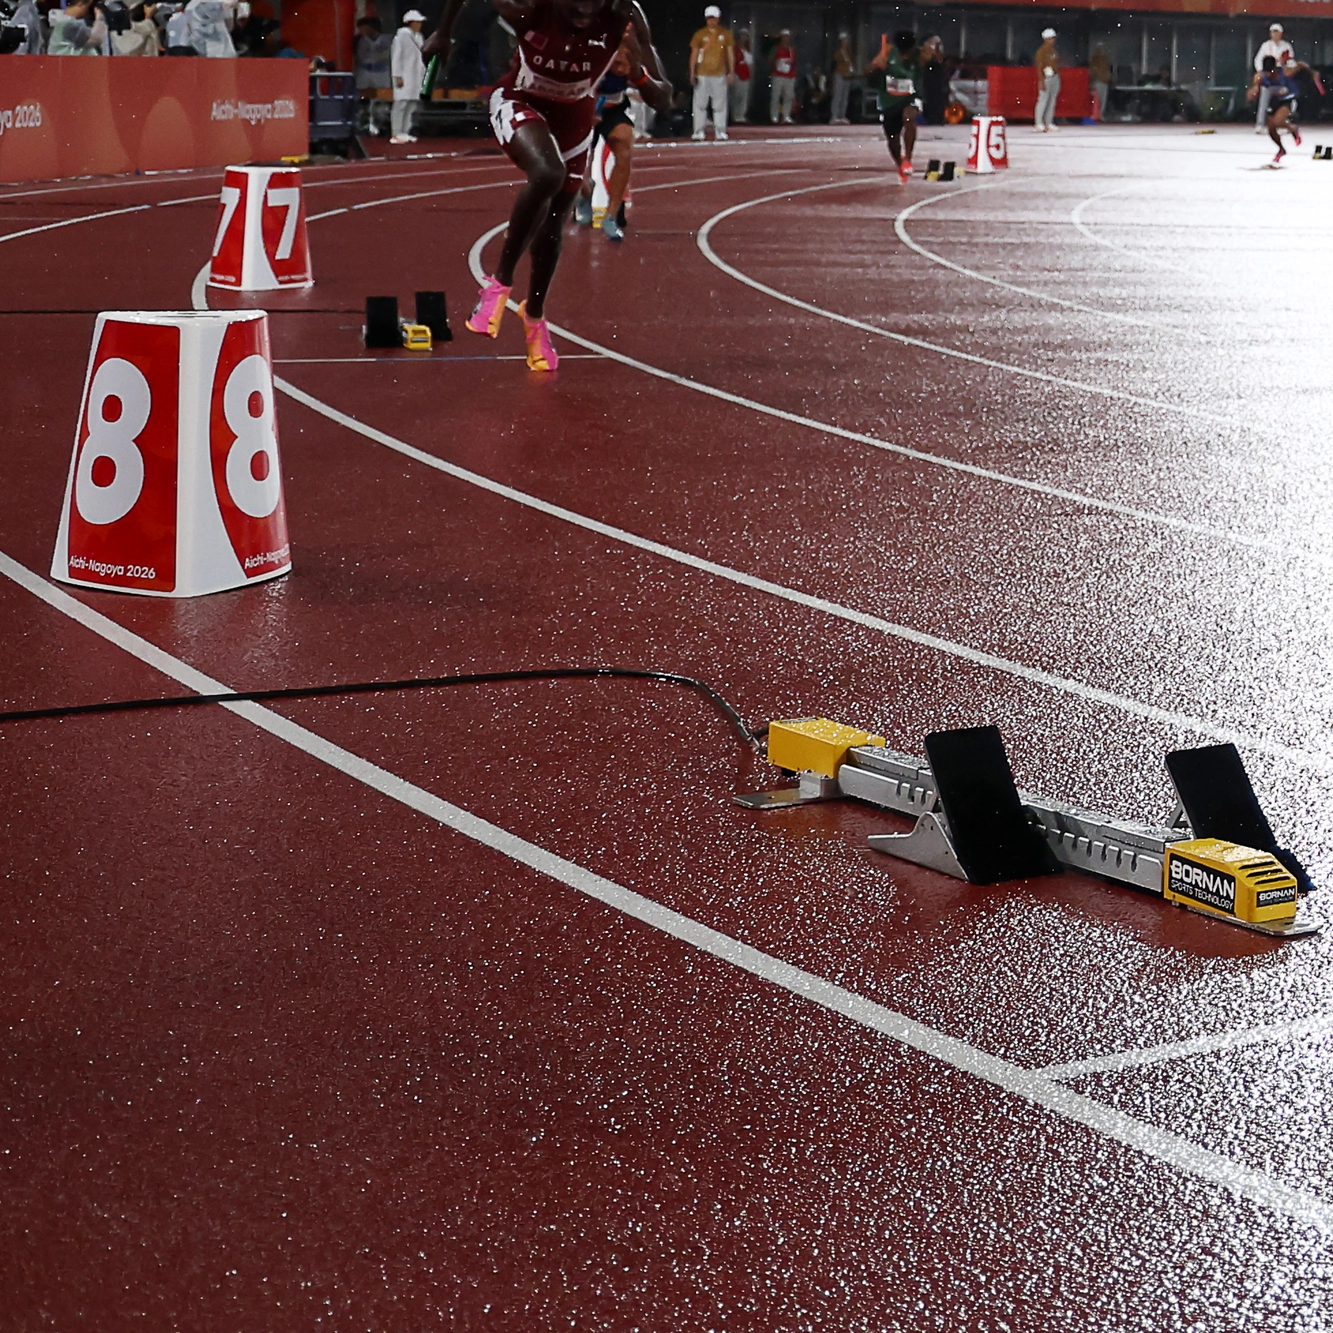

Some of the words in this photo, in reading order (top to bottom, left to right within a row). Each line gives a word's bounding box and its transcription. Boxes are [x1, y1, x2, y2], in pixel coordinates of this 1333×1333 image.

[532, 55, 592, 73] QATAR
[15, 102, 42, 128] 2026
[988, 126, 1006, 160] 5
[212, 186, 241, 257] 7
[266, 187, 300, 260] 7
[75, 357, 151, 525] 8
[224, 354, 280, 518] 8
[68, 555, 124, 577] Aichi-Nagoya
[126, 564, 156, 579] 2026
[1170, 859, 1235, 900] BORNAN
[1171, 879, 1194, 896] SPORTS
[1194, 887, 1234, 911] TECHNOLOGY
[1258, 888, 1296, 902] BORNAN
